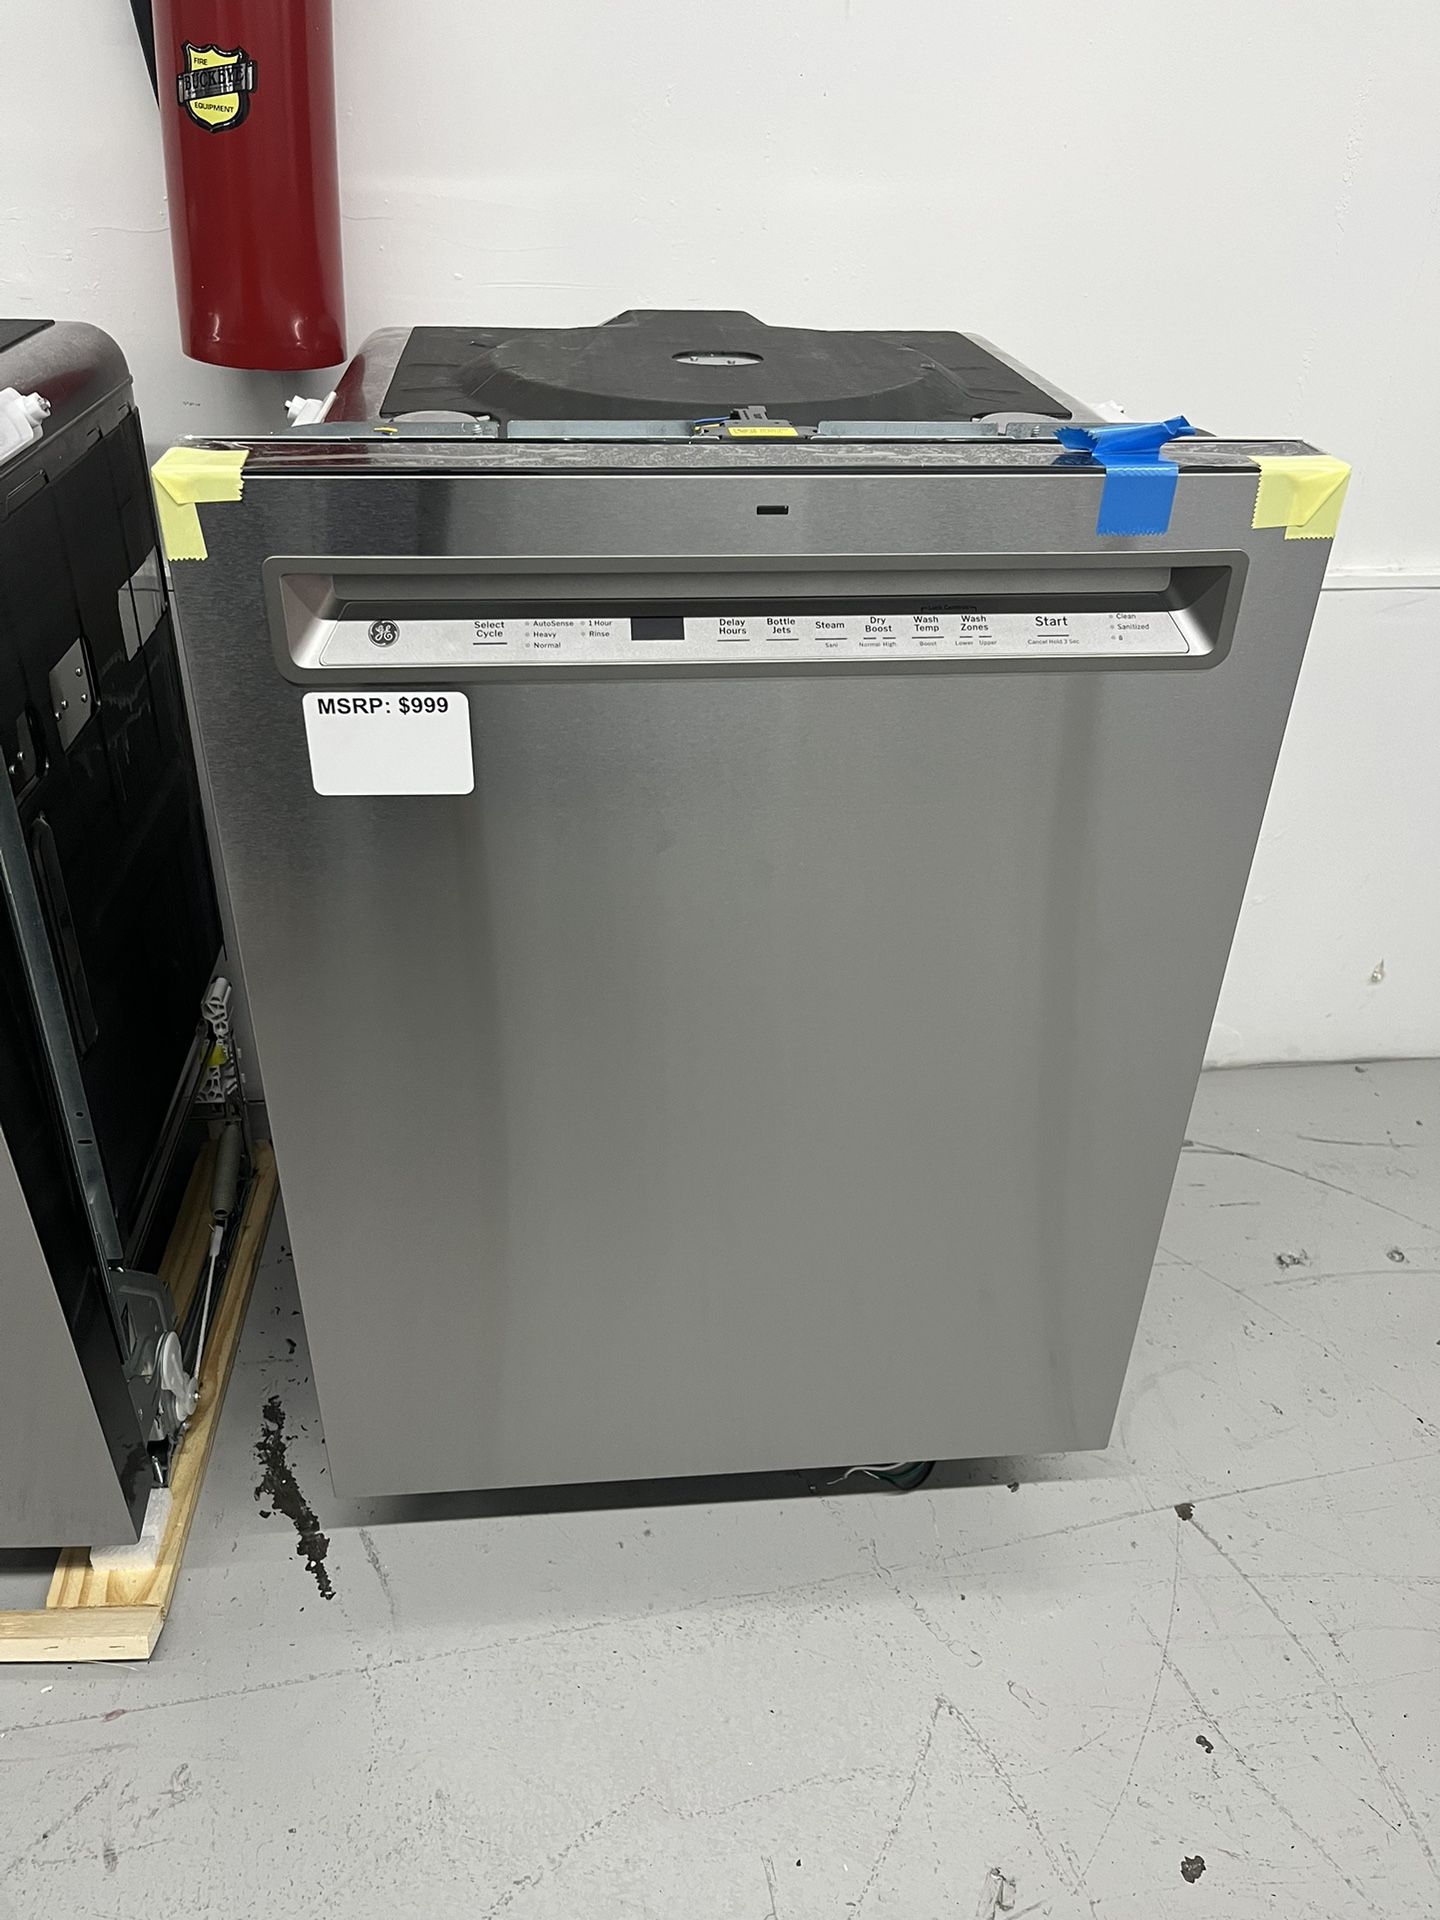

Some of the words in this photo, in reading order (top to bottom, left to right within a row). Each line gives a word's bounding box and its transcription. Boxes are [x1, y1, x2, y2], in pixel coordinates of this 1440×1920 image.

[193, 57, 208, 66] FIRE
[194, 101, 234, 113] EQUIPMENT
[719, 618, 746, 627] Delay
[766, 617, 796, 626] Bottle
[870, 616, 887, 625] Dry
[913, 615, 939, 623] Wash
[1035, 616, 1068, 627] Start
[474, 620, 505, 629] Select
[815, 621, 845, 629] Steam
[865, 624, 892, 632] Boost
[914, 624, 940, 632] Temp
[960, 623, 989, 631] Zones
[476, 629, 503, 639] Cycle
[719, 627, 747, 635] Hours
[772, 626, 791, 634] Jets
[533, 631, 557, 639] Heavy
[317, 697, 391, 714] MSRP:
[399, 696, 449, 715] $999
